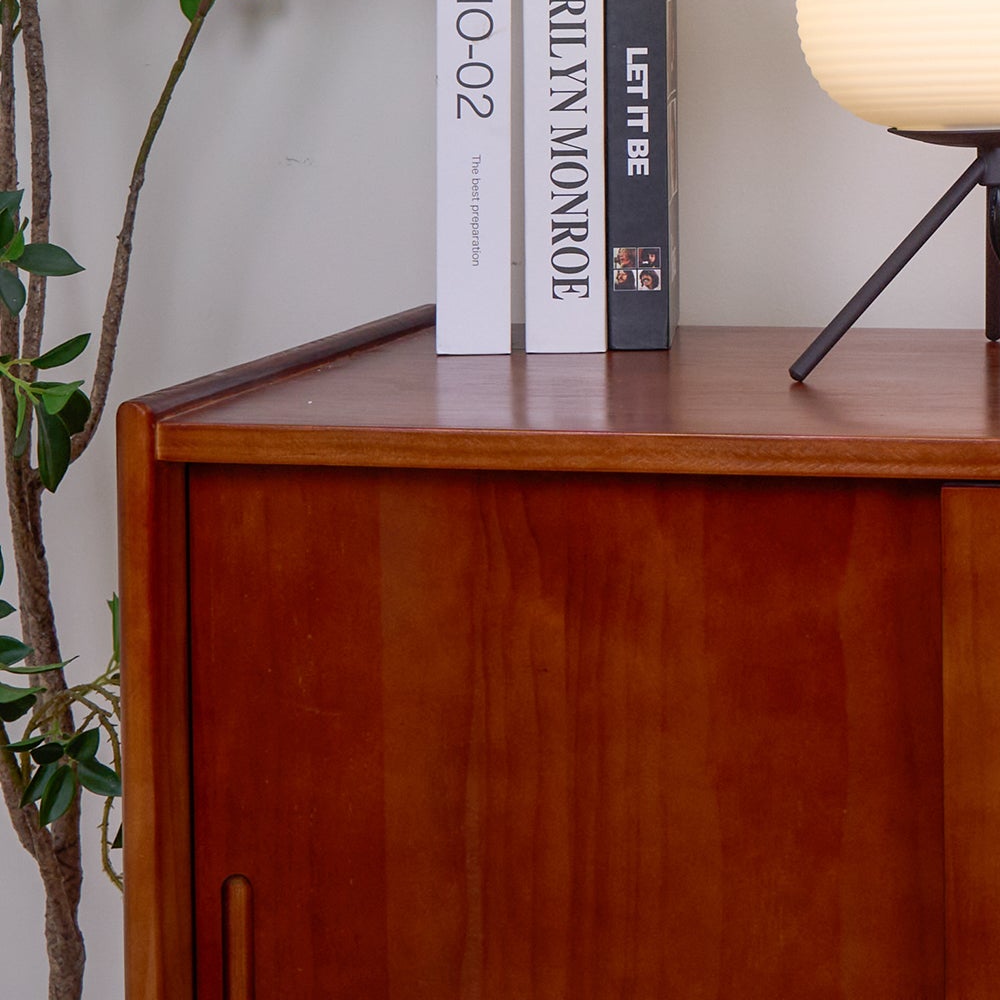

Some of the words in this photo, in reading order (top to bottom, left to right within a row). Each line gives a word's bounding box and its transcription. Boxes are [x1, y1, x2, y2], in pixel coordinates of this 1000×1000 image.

[626, 47, 649, 100] LET
[626, 106, 649, 133] IT
[471, 154, 481, 175] The
[627, 139, 650, 176] BE
[471, 178, 481, 202] best
[550, 124, 590, 300] MONROE
[469, 204, 481, 267] preparation
